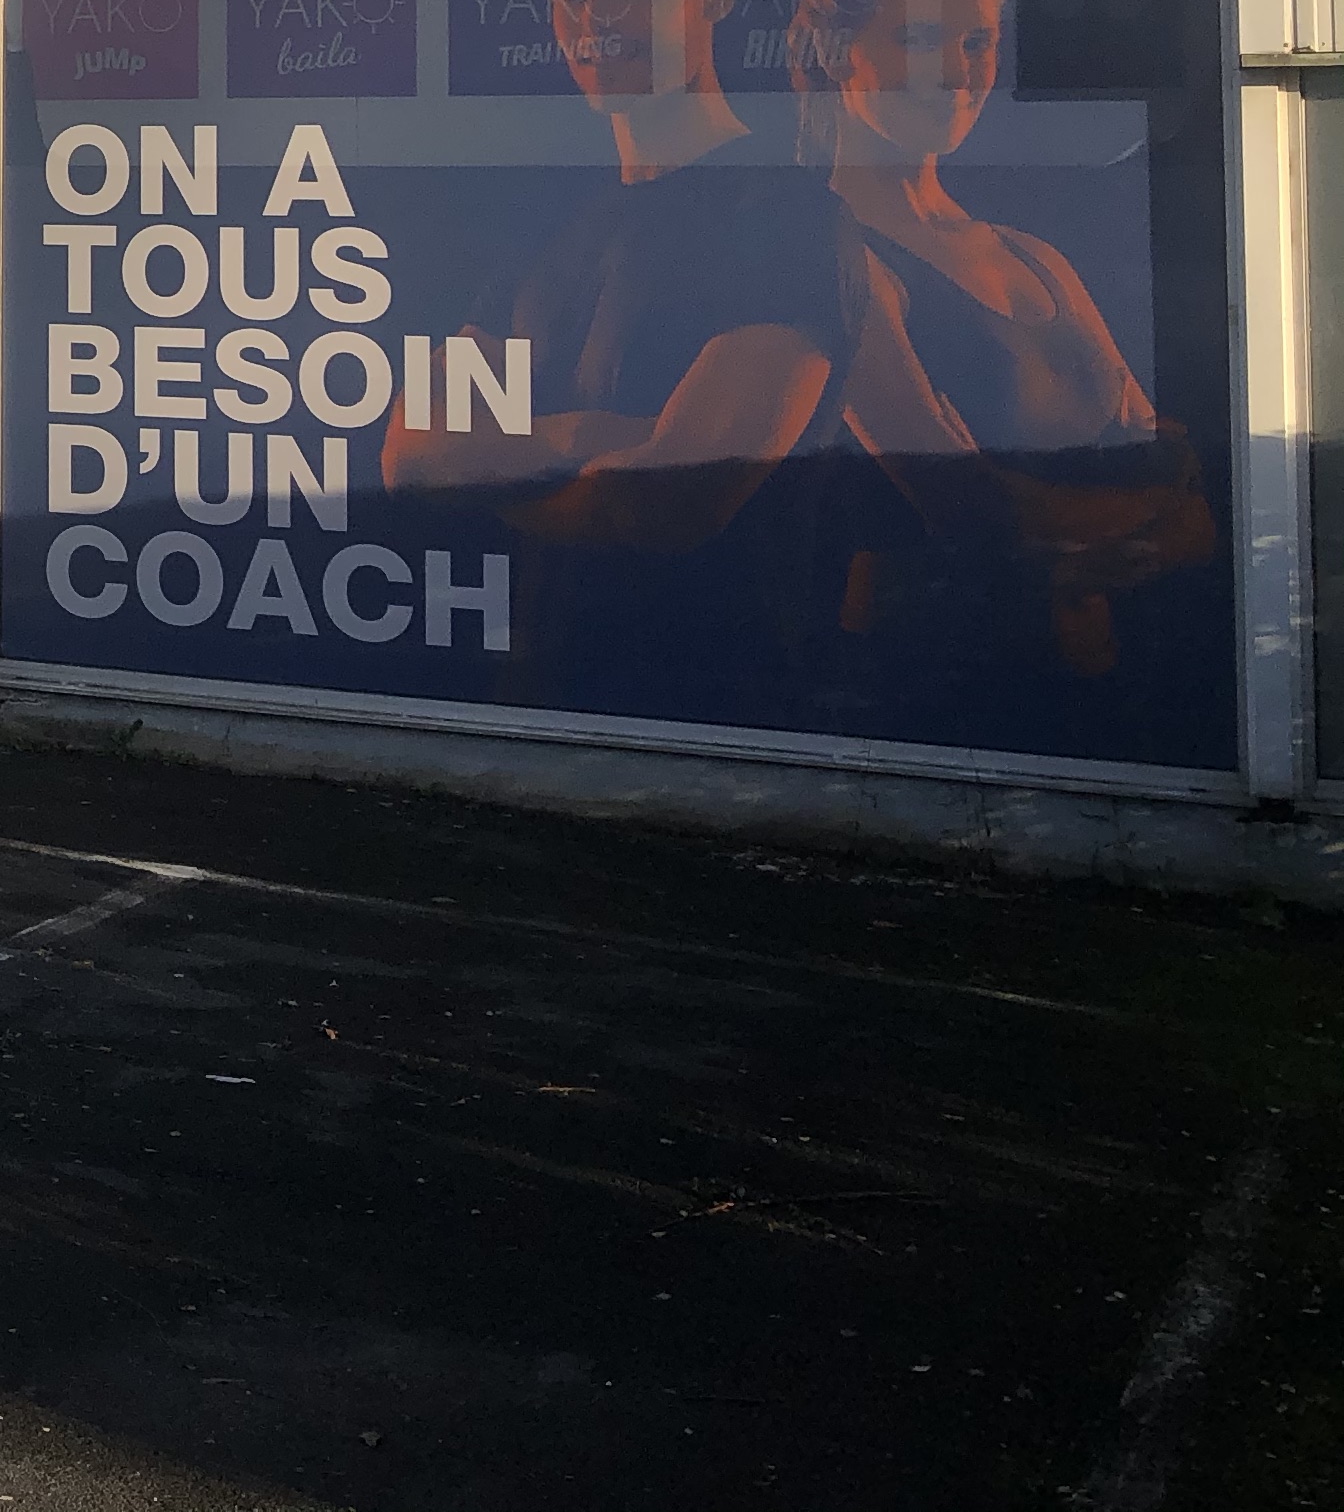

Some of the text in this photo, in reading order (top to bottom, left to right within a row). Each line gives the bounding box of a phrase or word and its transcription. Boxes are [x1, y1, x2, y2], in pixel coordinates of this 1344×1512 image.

[277, 32, 357, 75] baila
[45, 123, 356, 217] ON A
[42, 223, 393, 324] TOUS
[47, 322, 533, 437] BESOIN
[47, 422, 348, 532] D'UN
[45, 524, 511, 652] COACH
